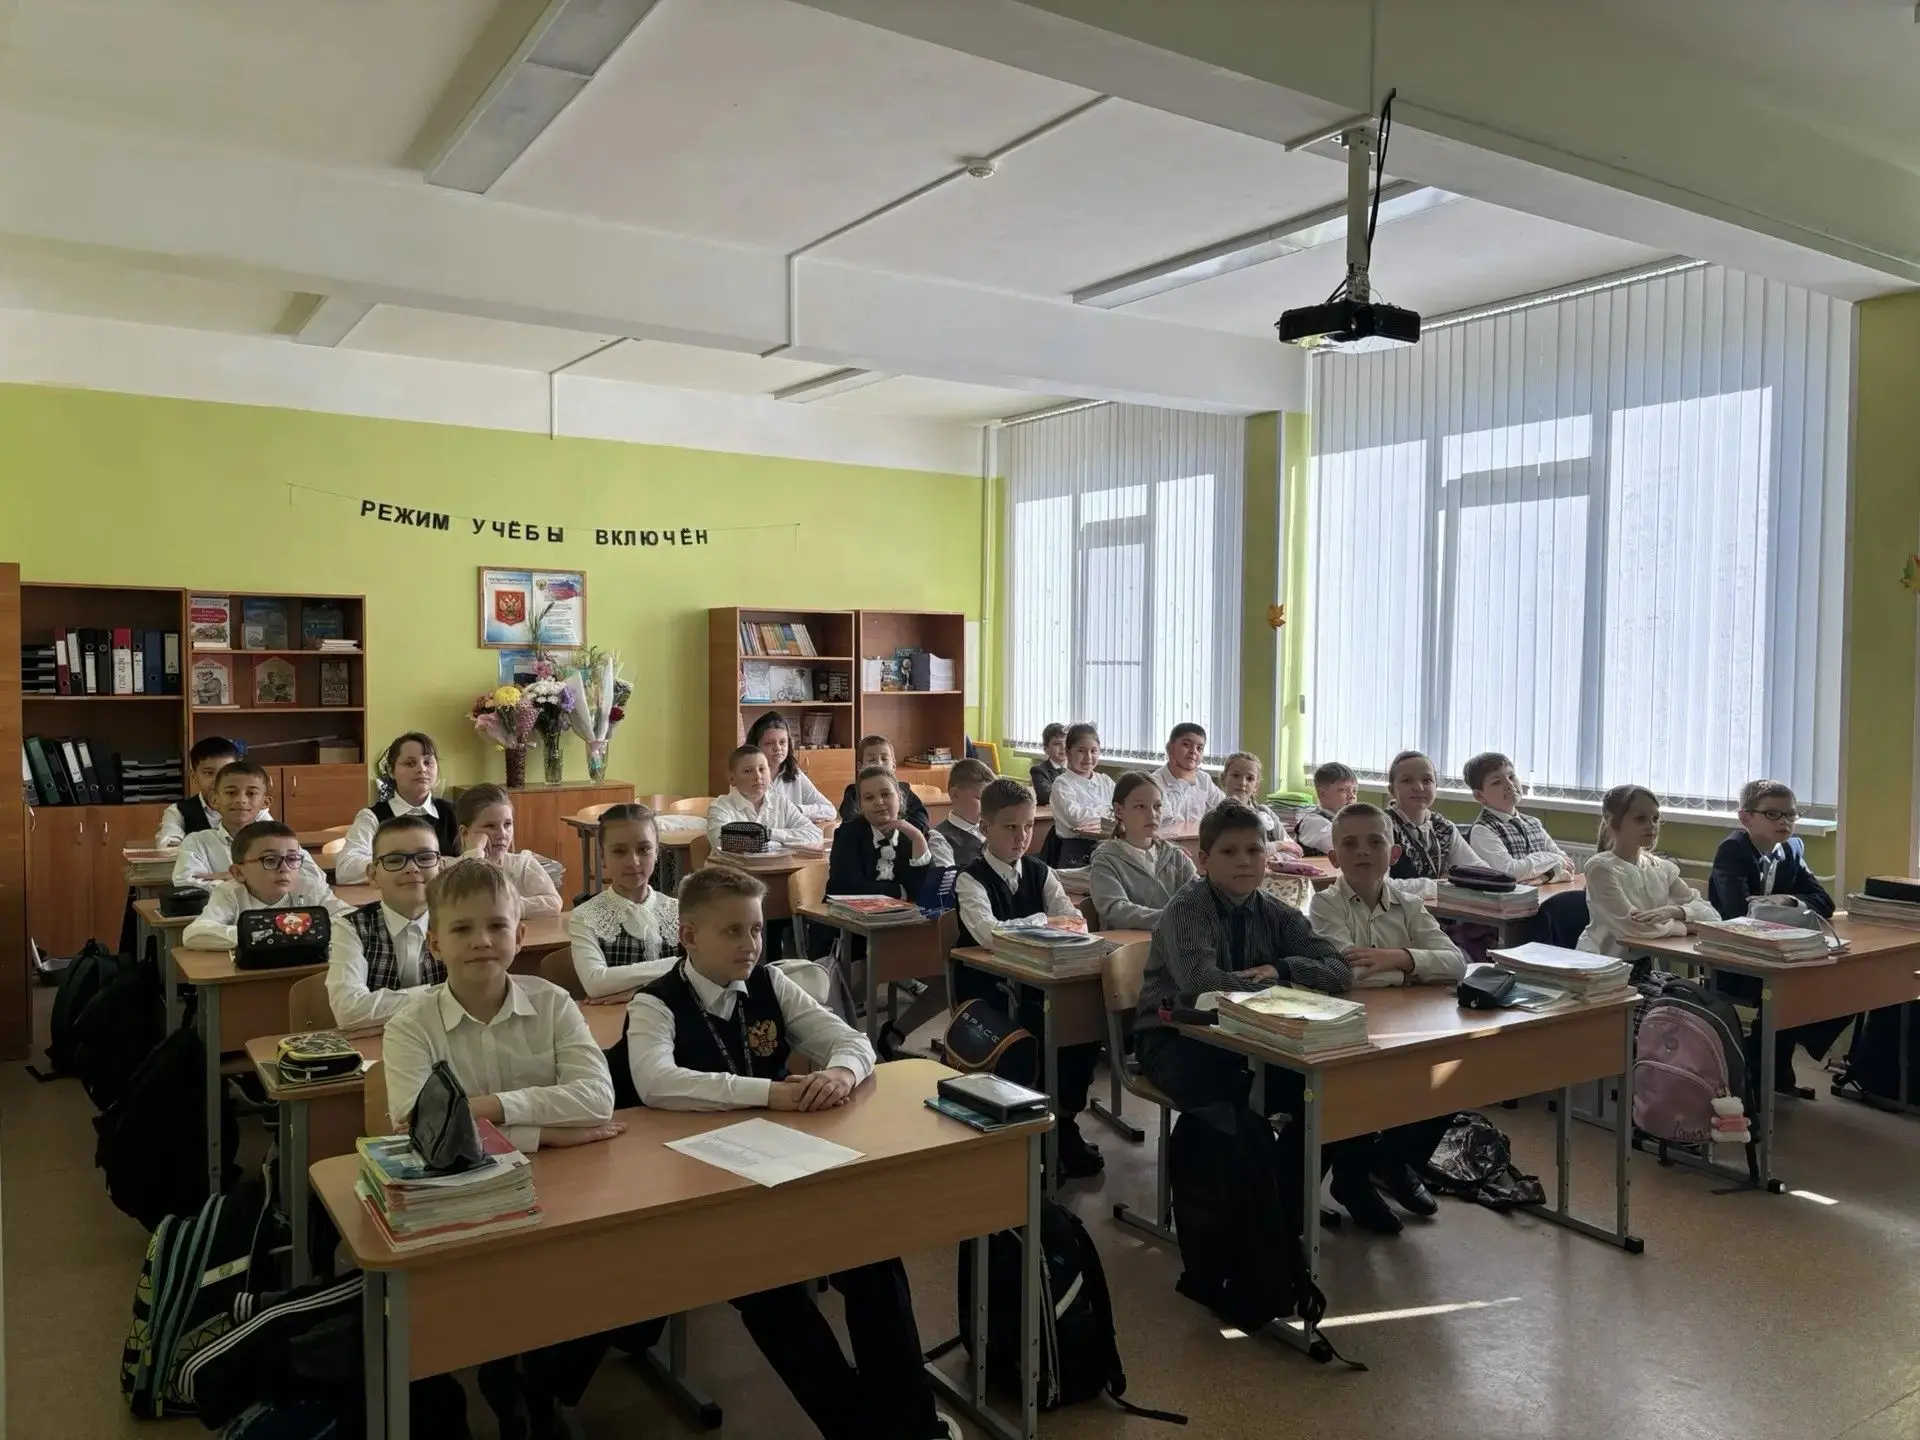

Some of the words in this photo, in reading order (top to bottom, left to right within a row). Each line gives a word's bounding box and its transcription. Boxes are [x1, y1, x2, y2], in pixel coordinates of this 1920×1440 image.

[360, 499, 450, 531] РЕЖИМ
[472, 518, 564, 543] УЧЁБЫ
[596, 529, 708, 546] ВКЛЮЧЁН
